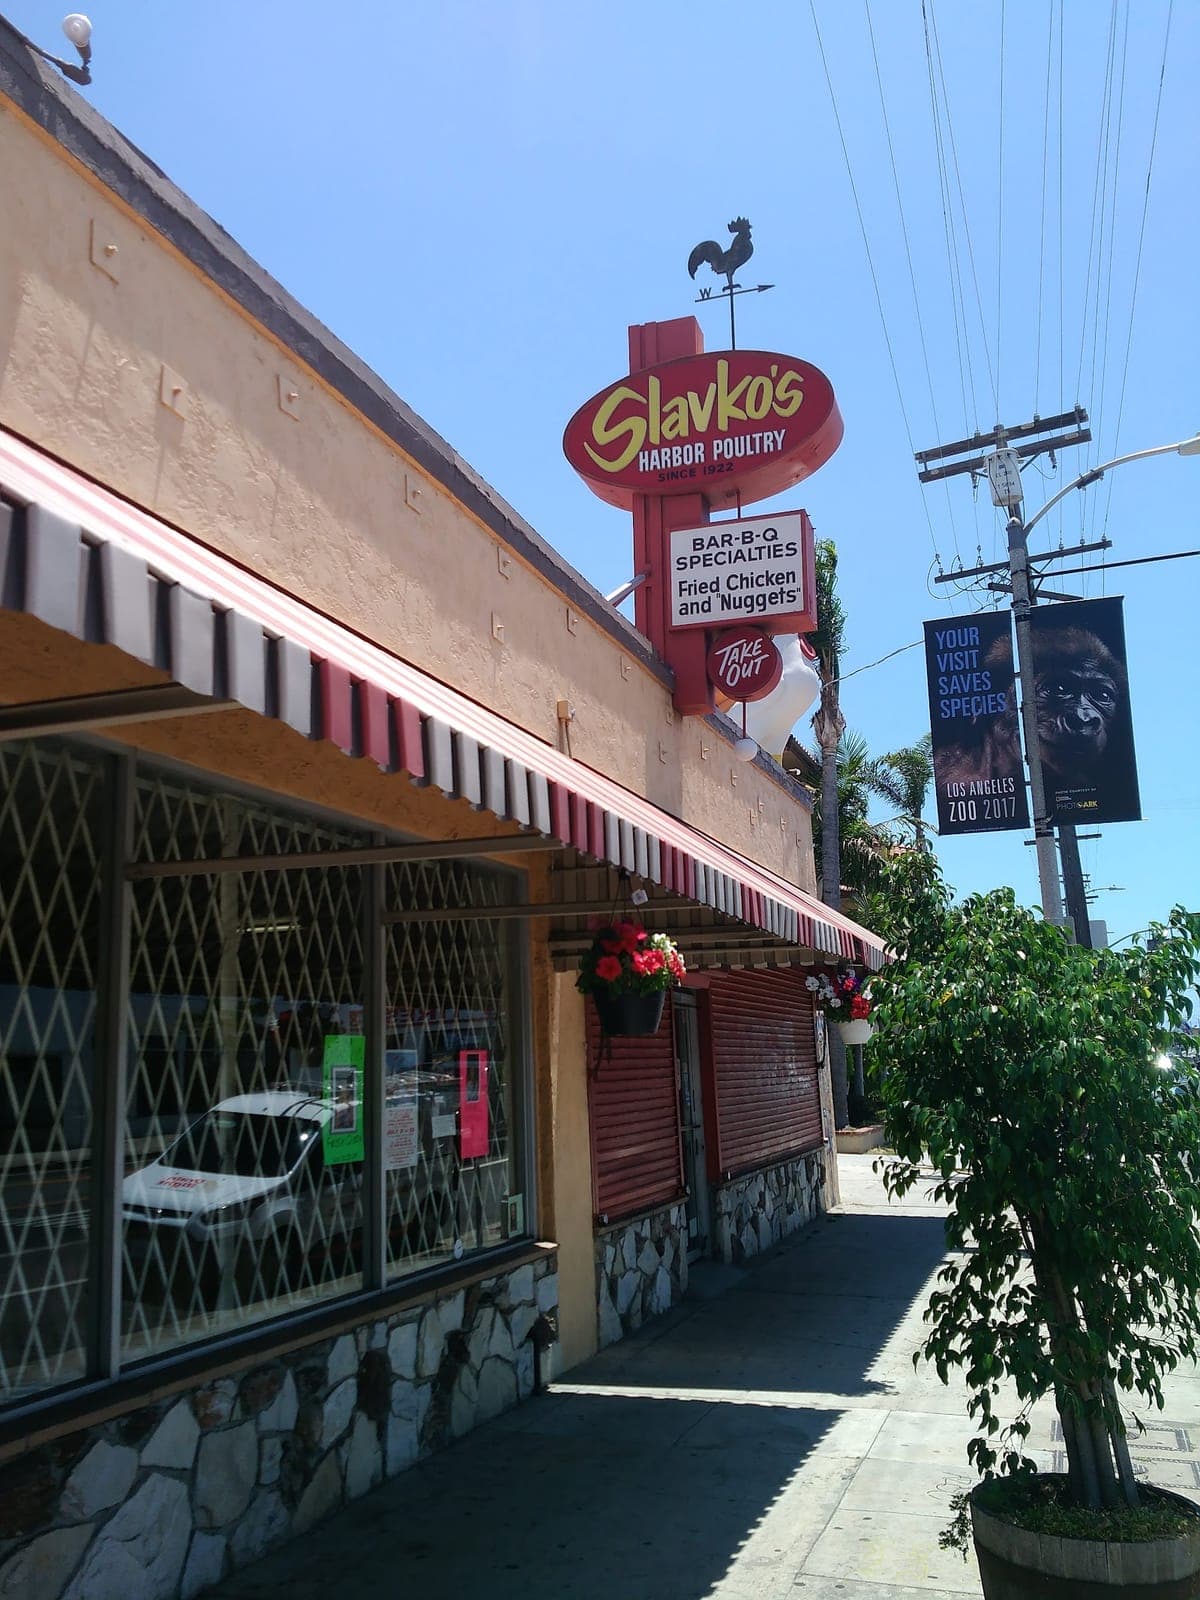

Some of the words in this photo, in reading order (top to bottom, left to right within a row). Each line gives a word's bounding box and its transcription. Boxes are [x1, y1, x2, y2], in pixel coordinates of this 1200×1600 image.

[584, 359, 804, 473] Slavko's
[639, 442, 705, 472] HARBOR
[713, 429, 786, 460] POULTRY
[658, 467, 696, 482] SINCE
[703, 462, 734, 476] 1922
[692, 527, 779, 552] BAR-B-Q
[676, 541, 798, 571] SPECIALTIES
[678, 576, 720, 598] Fried
[726, 569, 796, 591] Chicken
[679, 595, 712, 616] and
[716, 587, 801, 614] "Nuggets"
[935, 626, 980, 650] YOUR
[715, 637, 763, 677] TAKE
[937, 649, 979, 673] VISIT
[726, 654, 770, 688] OUT
[938, 671, 992, 696] SAVES
[940, 692, 1007, 719] SPECIES
[946, 782, 966, 798] LOS
[969, 777, 1015, 796] ANGELES
[949, 800, 977, 822] ZOO
[983, 797, 1016, 819] 2017
